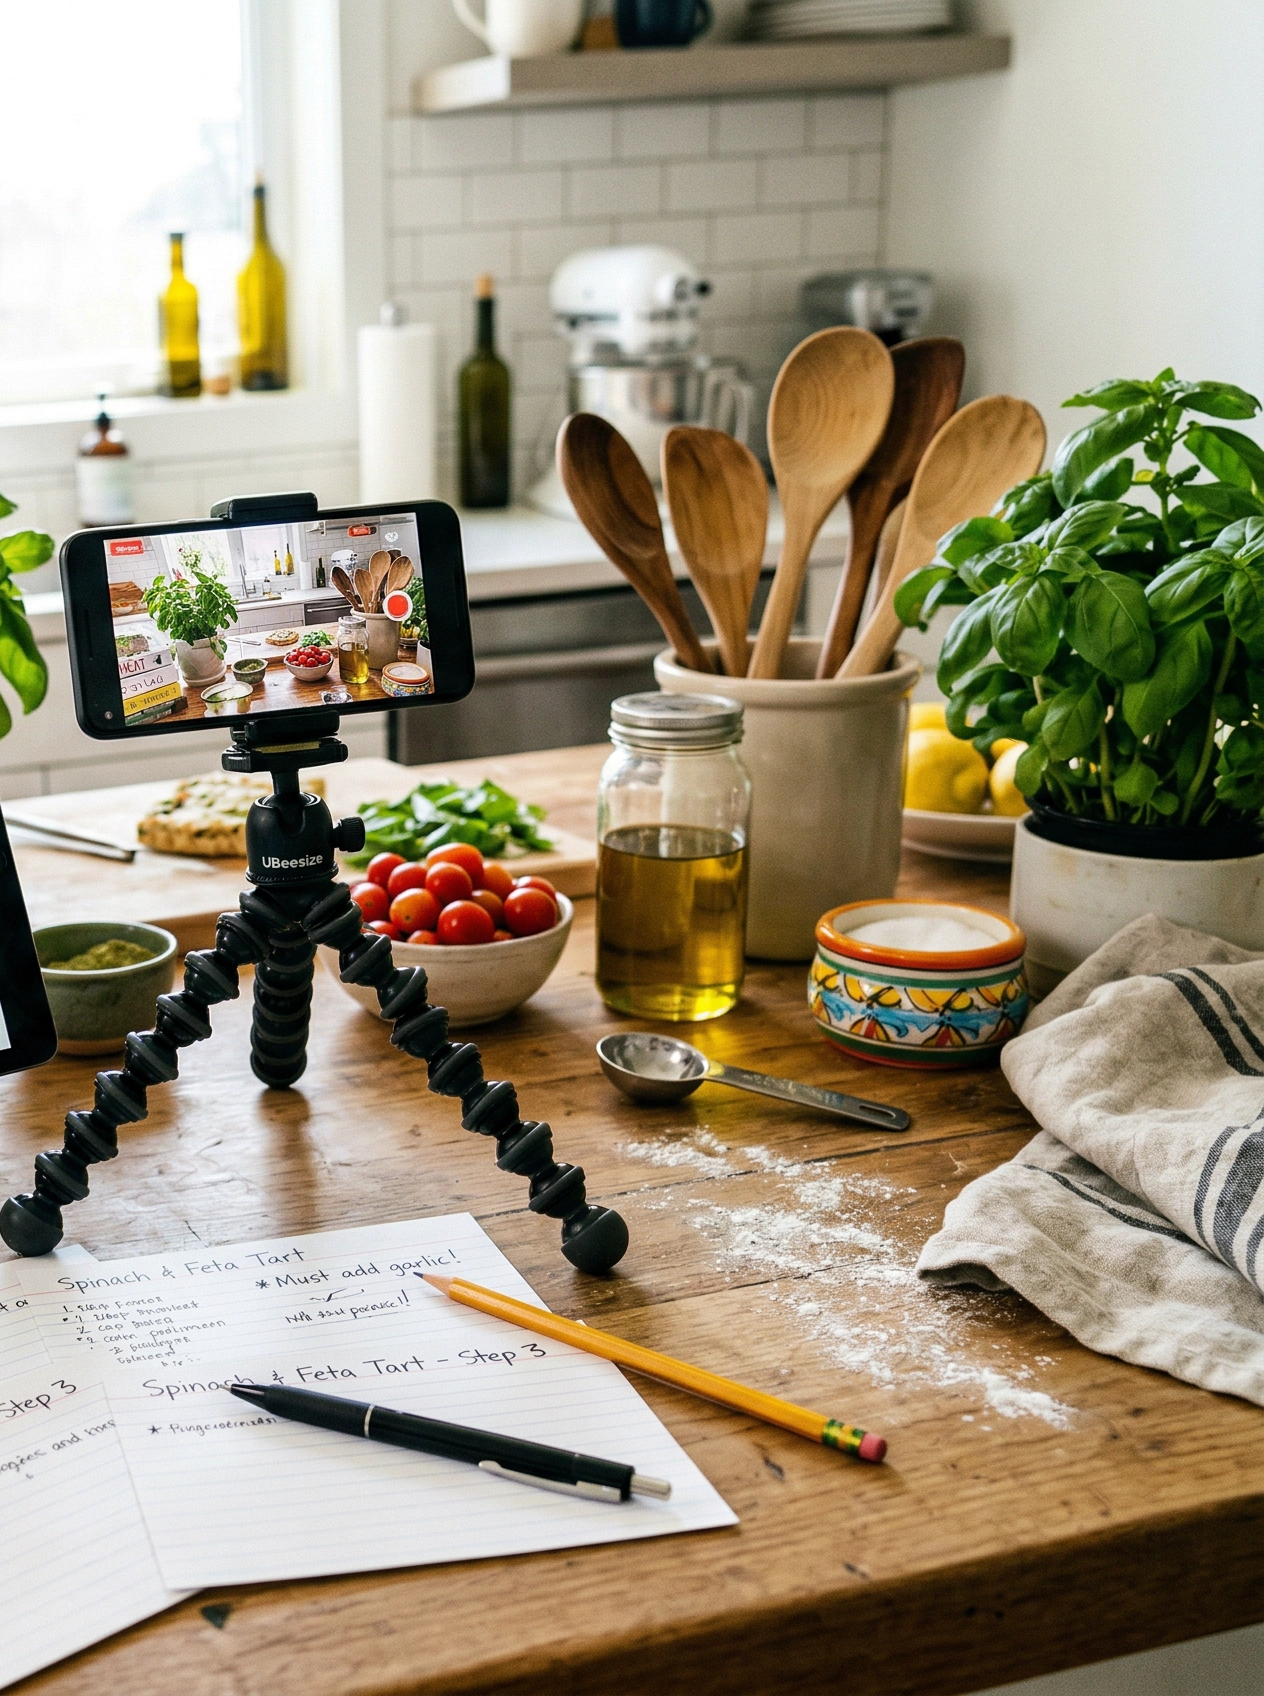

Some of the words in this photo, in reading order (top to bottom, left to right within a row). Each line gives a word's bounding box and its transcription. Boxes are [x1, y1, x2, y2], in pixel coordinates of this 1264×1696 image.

[261, 854, 324, 869] UBeesize
[57, 1269, 151, 1294] Spinach
[161, 1265, 176, 1279] &
[184, 1260, 239, 1276] Feta
[245, 1247, 305, 1267] Tart
[342, 1262, 381, 1279] add
[389, 1248, 462, 1277] garlic!
[272, 1370, 285, 1385] &
[296, 1364, 357, 1383] Feta
[362, 1355, 425, 1375] Tart
[458, 1348, 516, 1367] Step
[521, 1343, 547, 1358] 3
[50, 1379, 77, 1395] 3
